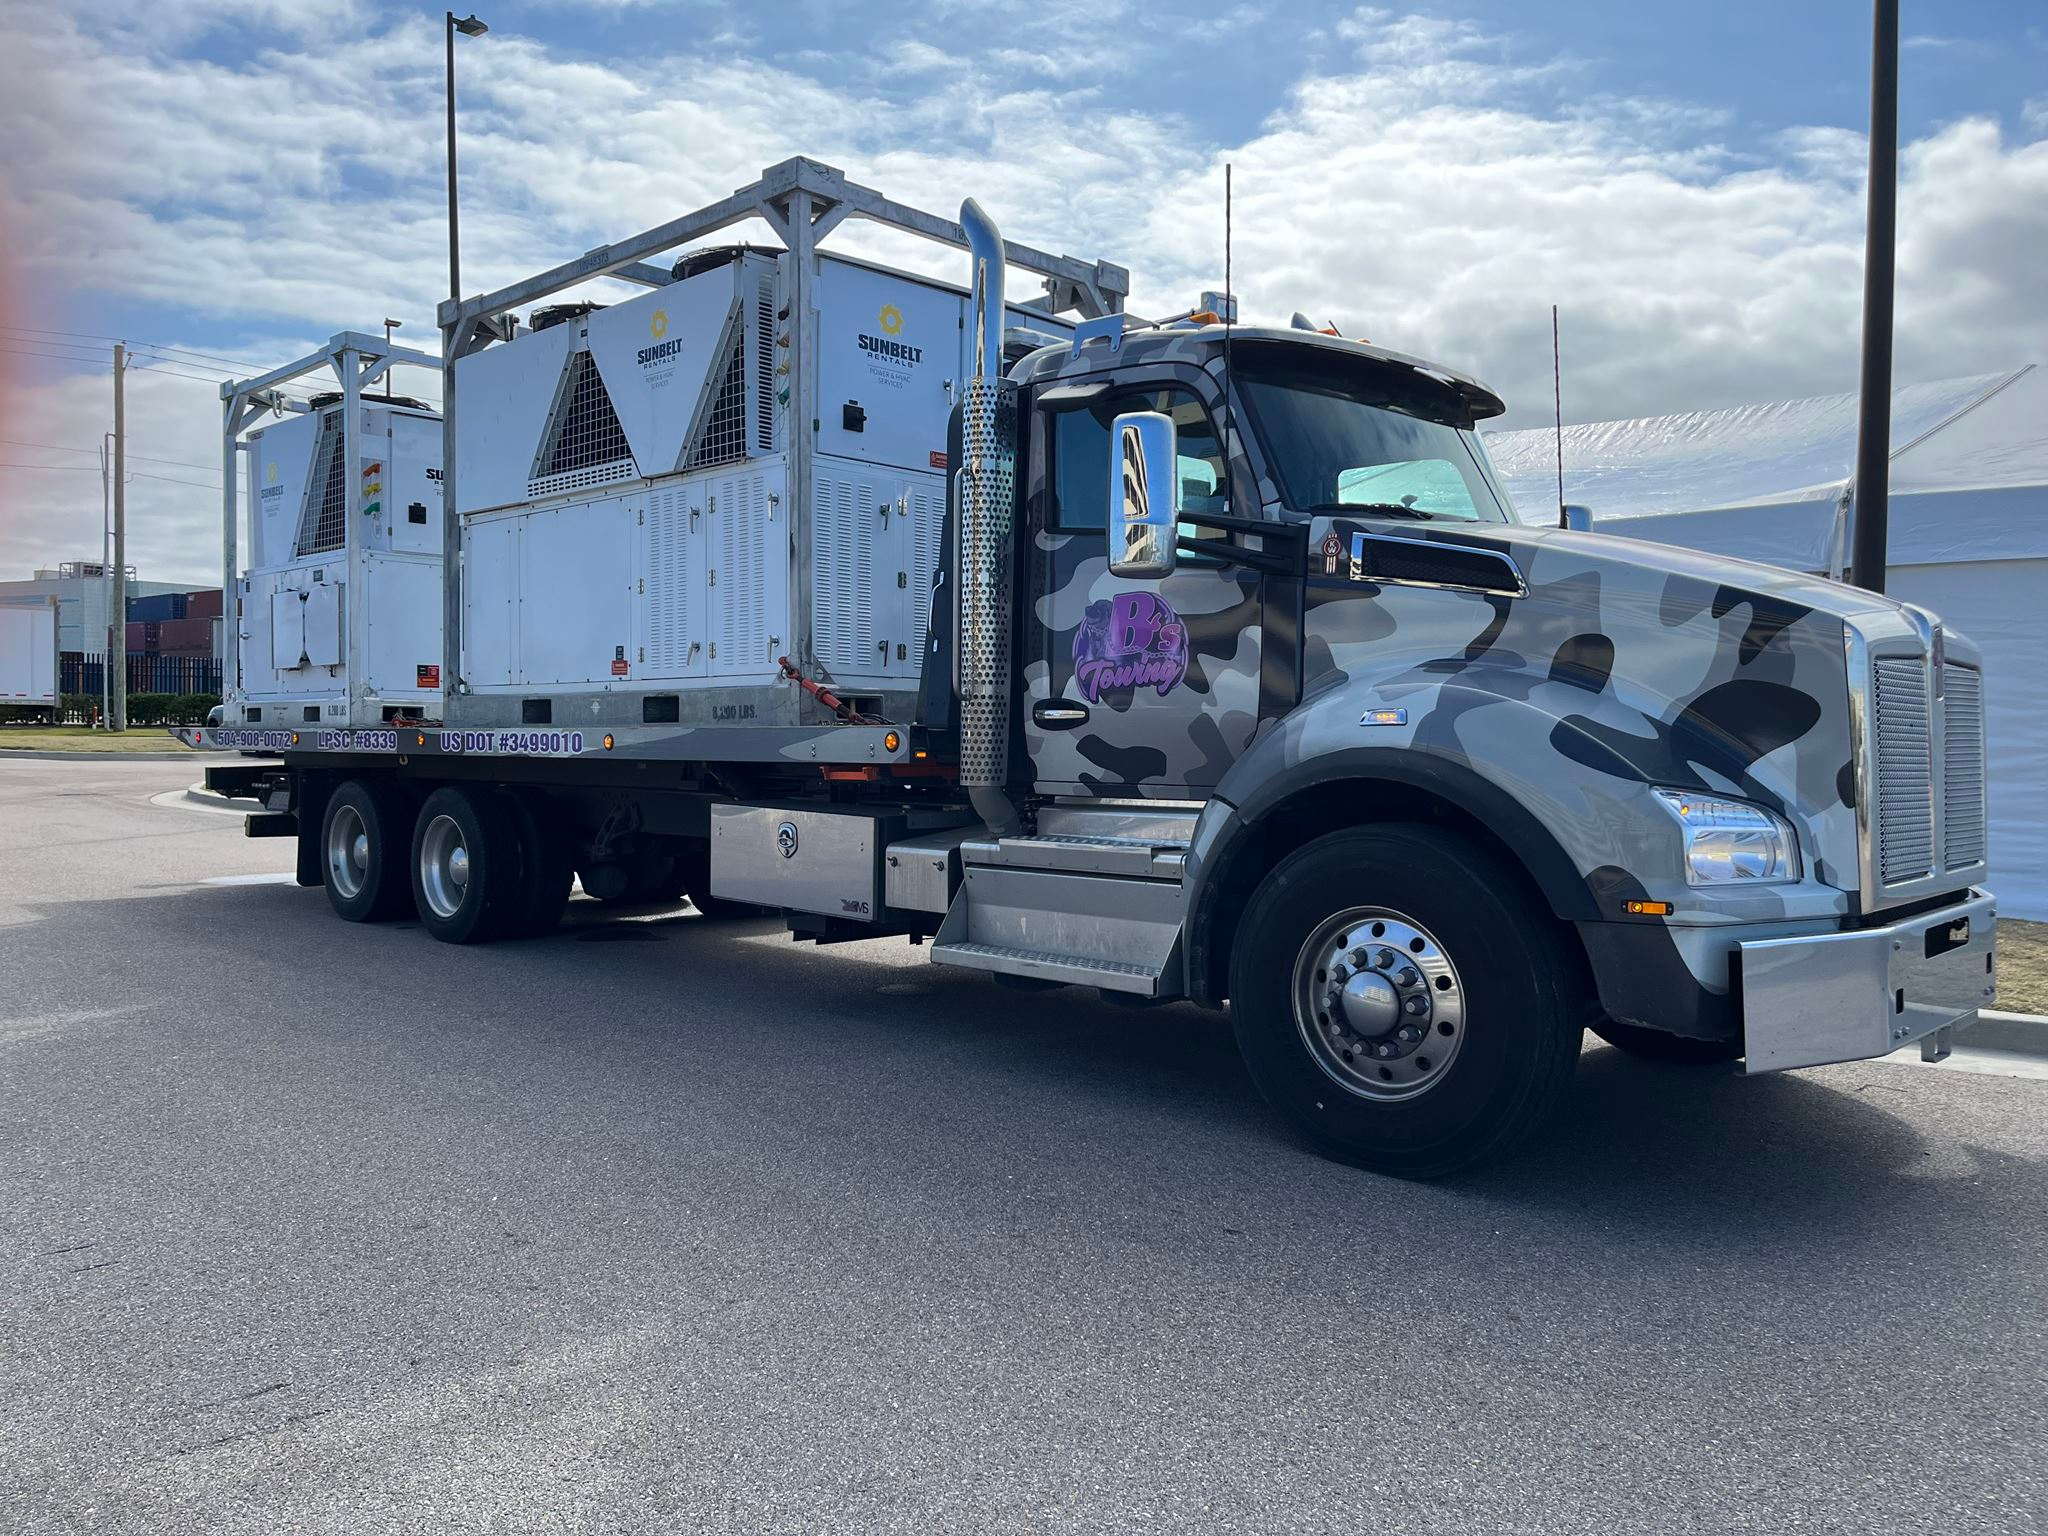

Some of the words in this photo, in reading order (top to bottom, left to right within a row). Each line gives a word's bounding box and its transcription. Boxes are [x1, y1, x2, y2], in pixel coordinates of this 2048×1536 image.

[638, 338, 683, 365] SUNBELT
[858, 334, 922, 363] SUNBELT
[644, 355, 676, 370] RENTALS
[867, 352, 913, 368] RENTALS
[870, 368, 890, 378] POWER
[1105, 591, 1181, 657] B's
[1079, 658, 1182, 704] Towing
[217, 730, 291, 748] 504-908-0072
[318, 731, 350, 748] LPSC
[355, 731, 397, 749] #8339
[441, 732, 461, 750] US
[465, 732, 495, 751] DOT
[500, 733, 583, 753] #3499010
